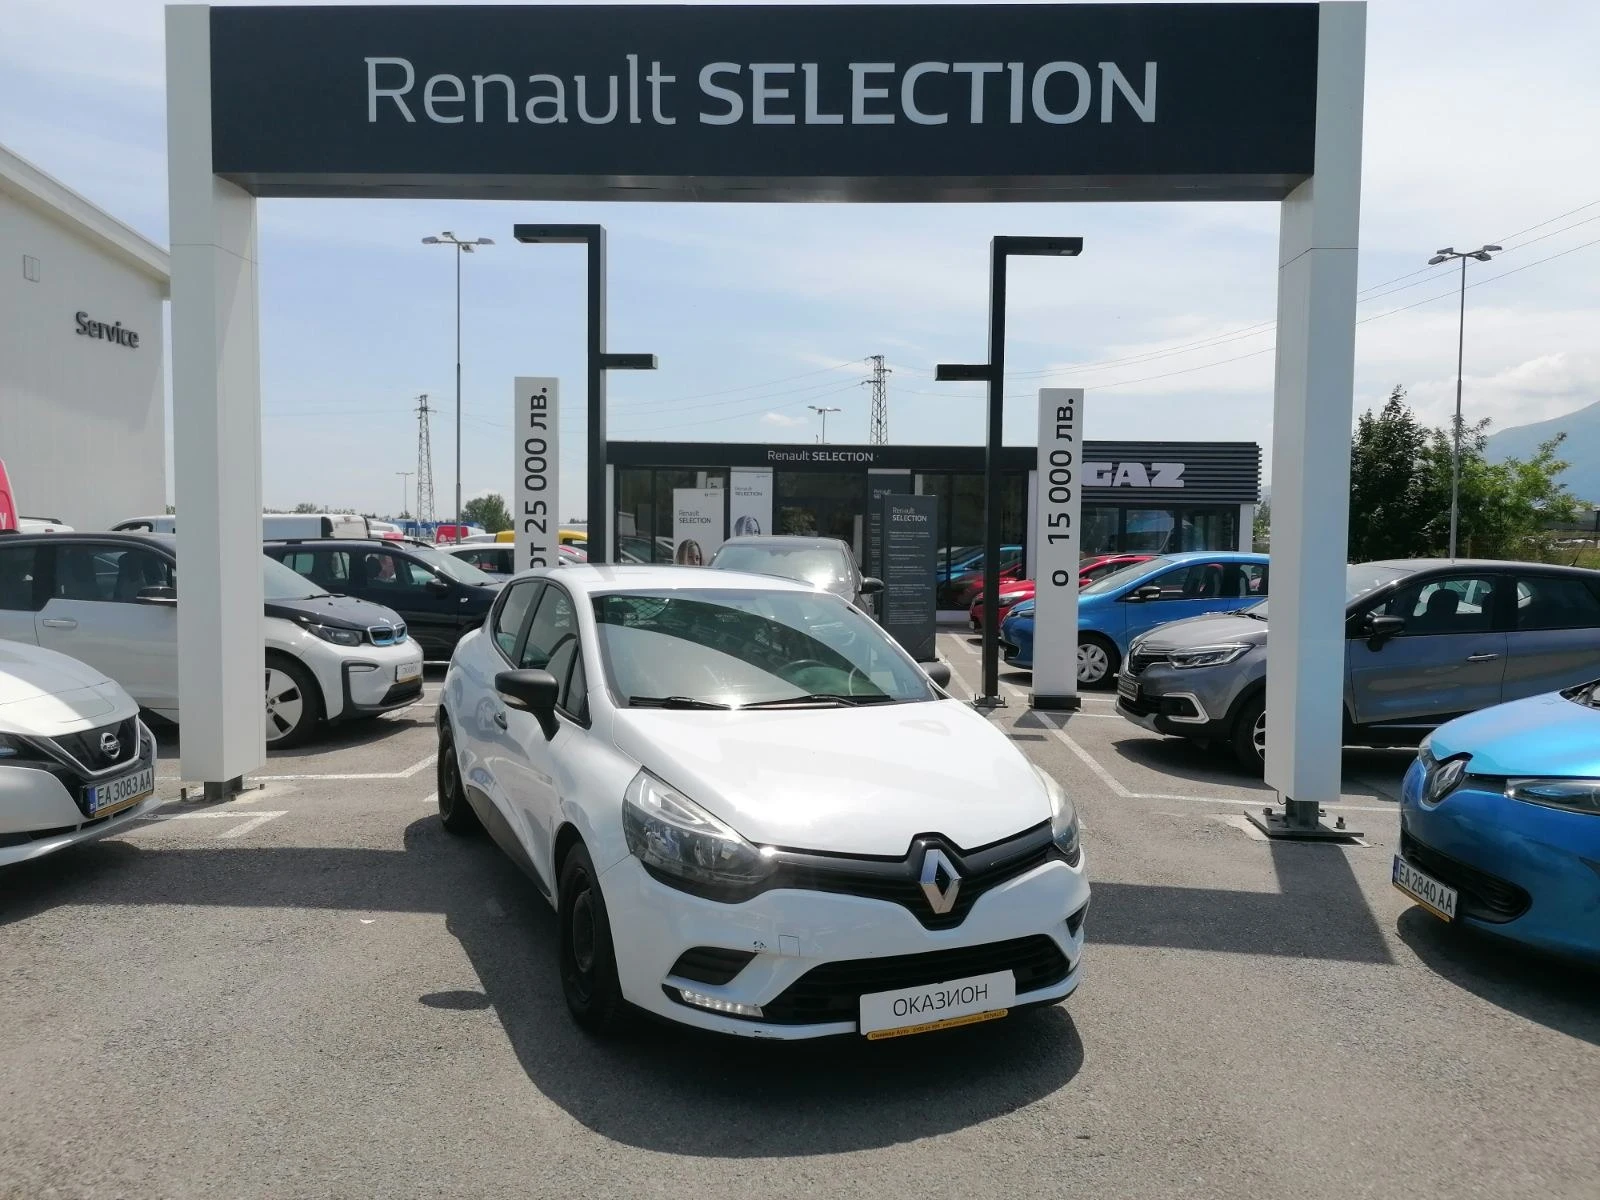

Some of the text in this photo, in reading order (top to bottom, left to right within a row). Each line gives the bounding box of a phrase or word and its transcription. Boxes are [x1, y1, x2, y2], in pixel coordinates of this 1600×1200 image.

[365, 54, 1158, 126] Renault SELECTION
[75, 311, 140, 349] Service
[530, 387, 547, 430] лв.
[1055, 398, 1074, 442] лв.
[525, 438, 547, 491] 000
[767, 450, 874, 462] Renault SELECTION
[1081, 461, 1185, 488] GAZ
[1048, 449, 1072, 503] 000
[525, 501, 547, 533] 25
[1047, 513, 1070, 544] 15
[97, 770, 152, 806] EA 3083 AA
[1399, 863, 1453, 914] EA 2840 AA
[893, 983, 988, 1017] ОКАЗИОН
